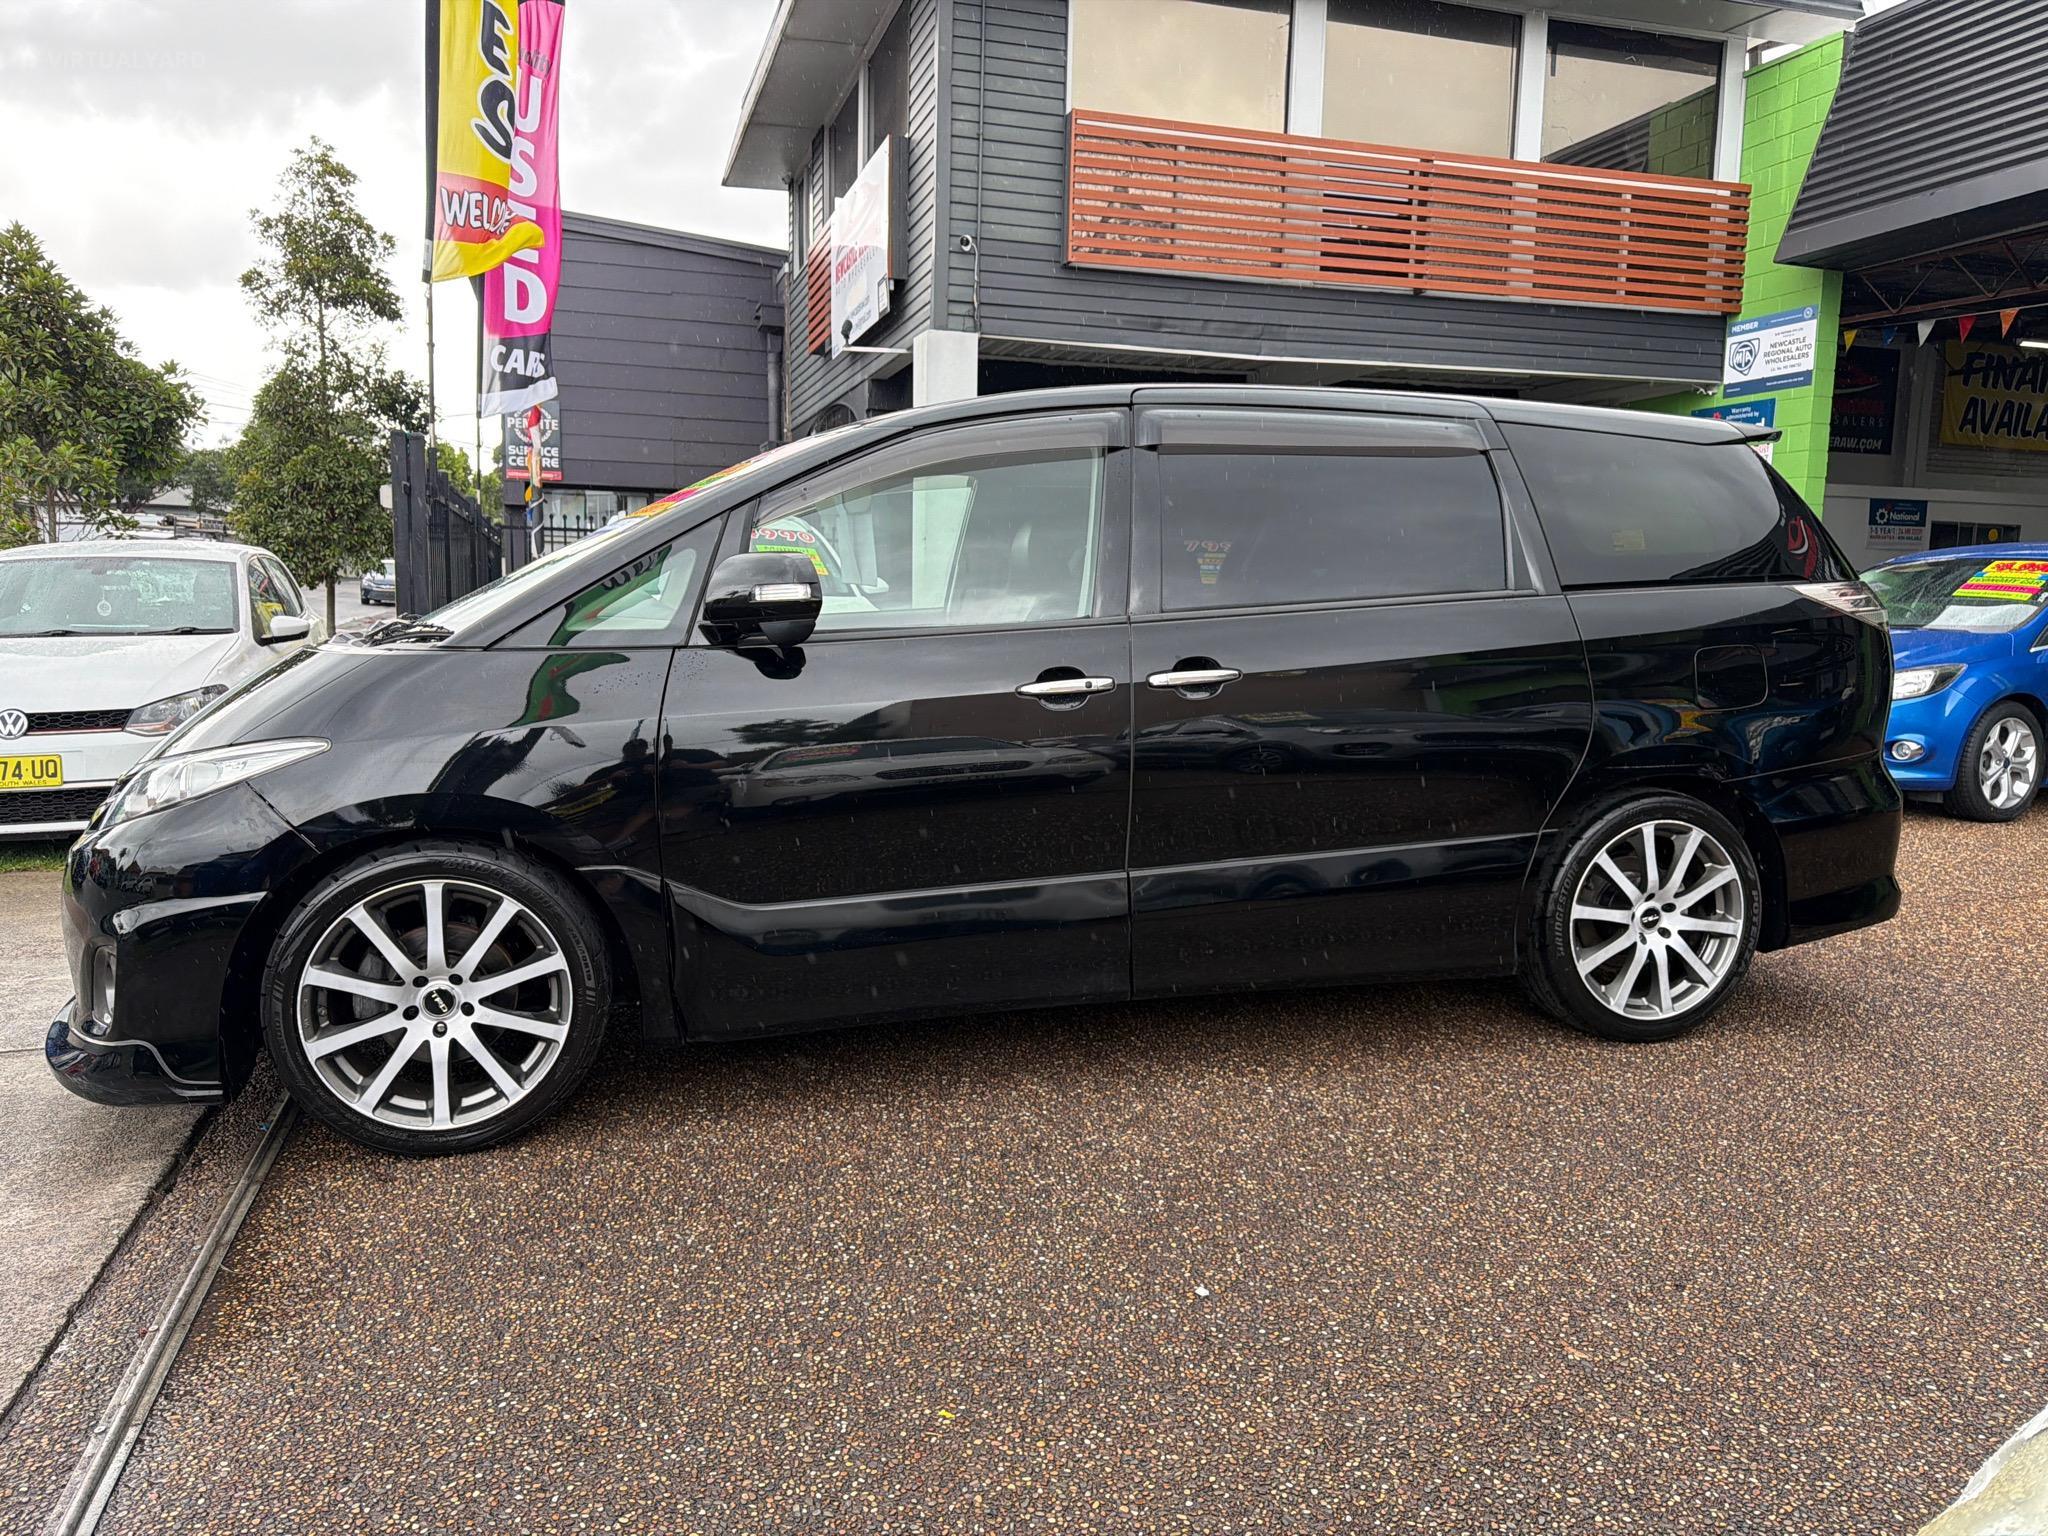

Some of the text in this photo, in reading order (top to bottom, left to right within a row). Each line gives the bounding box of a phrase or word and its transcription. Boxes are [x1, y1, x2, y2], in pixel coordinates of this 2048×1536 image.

[1731, 321, 1760, 334] MEMBER
[1770, 336, 1807, 350] NEWCASTLE
[1763, 343, 1813, 359] REGIONAL AUTO
[1765, 351, 1810, 366] WHOLESALERS
[506, 416, 559, 431] PENITE
[508, 445, 559, 457] SERICE
[508, 455, 560, 469] CERE
[1890, 511, 1920, 521] National
